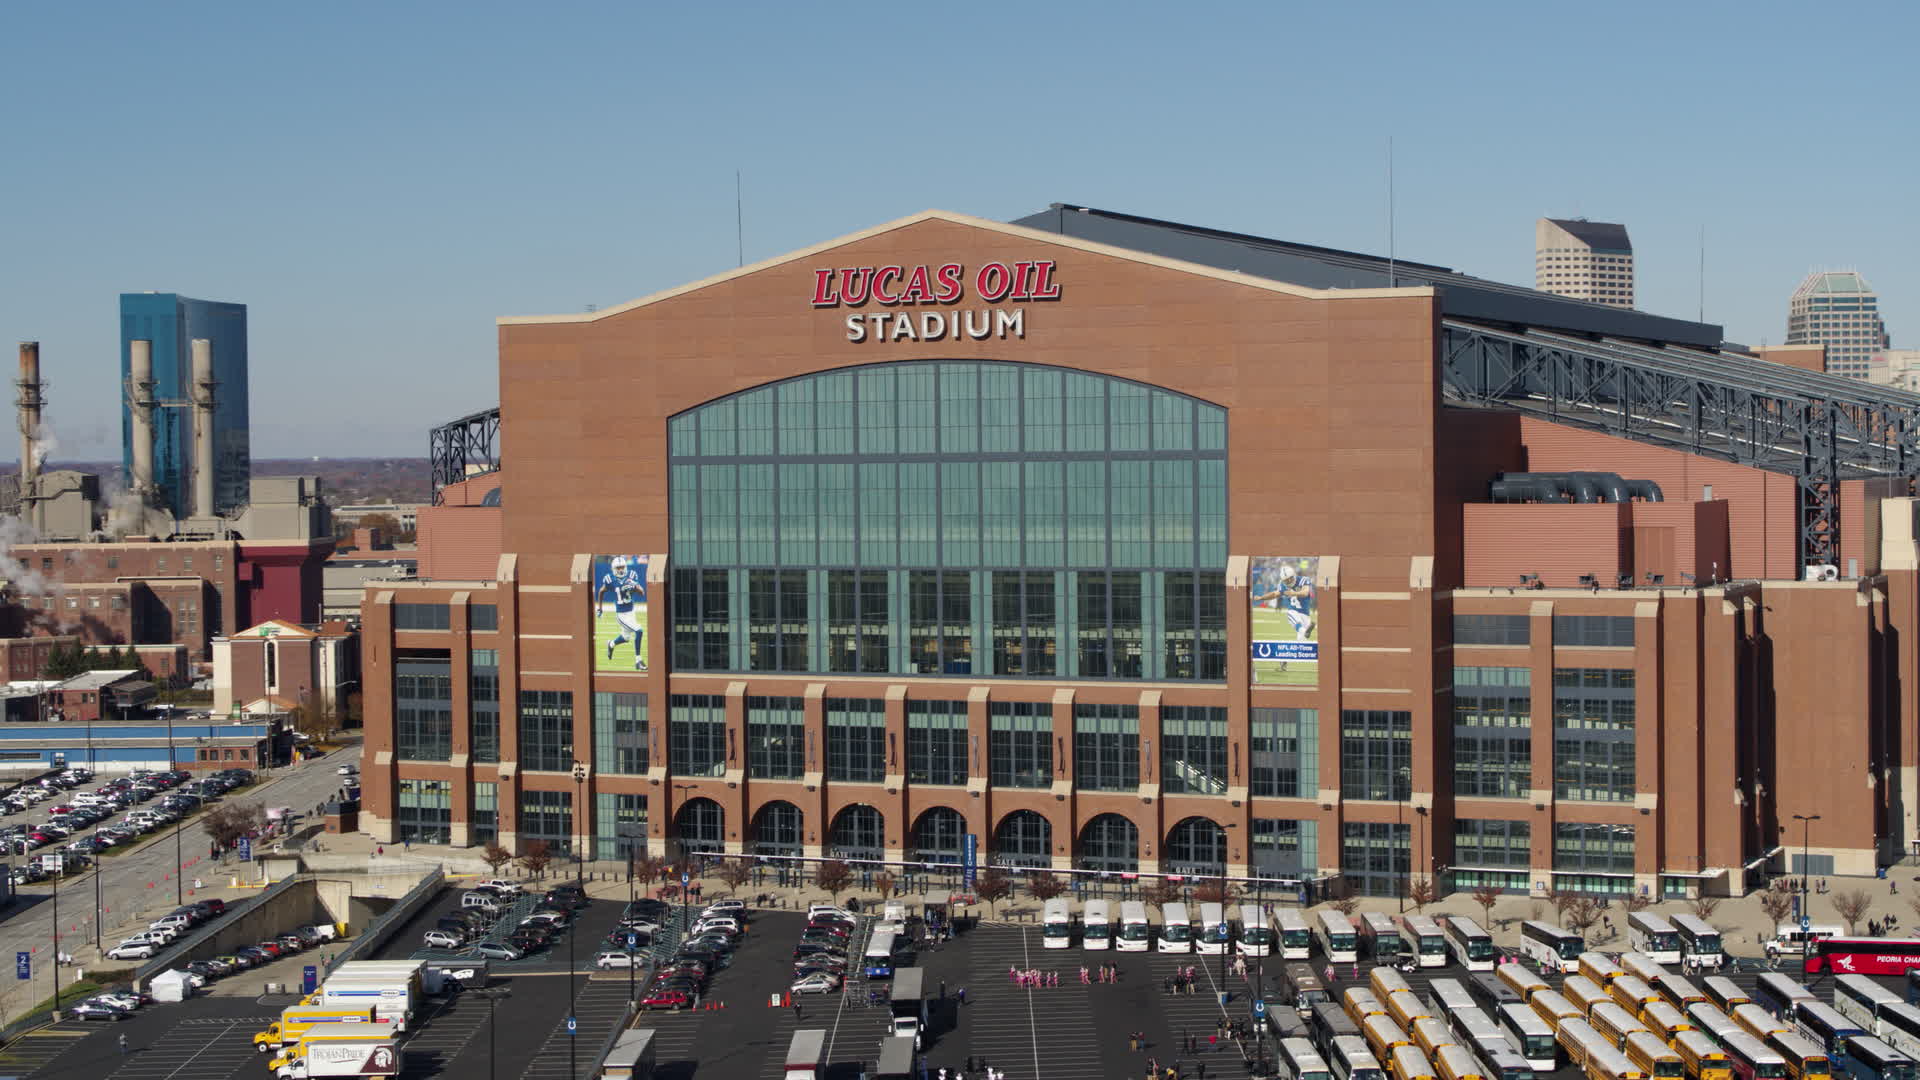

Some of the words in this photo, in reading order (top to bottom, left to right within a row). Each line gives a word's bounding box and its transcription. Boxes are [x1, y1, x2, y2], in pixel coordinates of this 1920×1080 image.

[810, 263, 965, 308] LUCAS
[976, 260, 1062, 302] OIL
[846, 308, 1024, 342] STADIUM
[1275, 651, 1297, 659] Leading
[1175, 866, 1197, 875] GATE
[20, 955, 26, 965] 2
[1876, 955, 1902, 963] PEORIA
[1903, 956, 1920, 964] CHA
